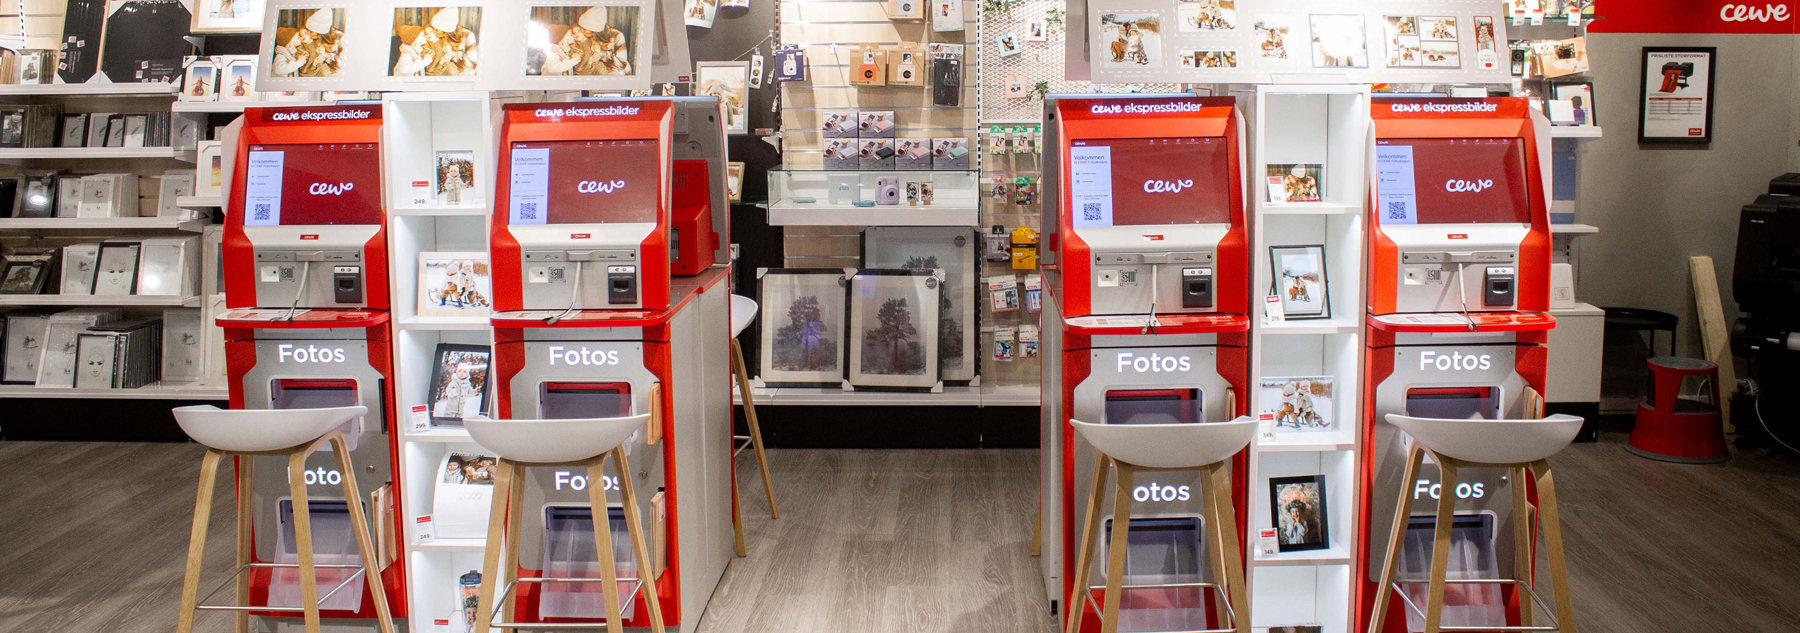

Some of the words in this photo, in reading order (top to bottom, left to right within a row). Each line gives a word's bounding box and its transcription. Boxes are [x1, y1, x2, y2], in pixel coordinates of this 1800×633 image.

[1720, 4, 1791, 22] cewe
[273, 112, 300, 121] cewe
[301, 109, 371, 121] ekspressbilder
[535, 108, 564, 117] cewe
[566, 105, 640, 118] ekspressbilder
[1091, 104, 1123, 114] cewe
[1124, 102, 1202, 115] ekspressbilder
[1391, 103, 1421, 113] cewe
[1423, 101, 1498, 114] ekspressbilder
[279, 344, 345, 363] Fotos
[549, 346, 619, 366] Fotos
[1117, 352, 1191, 373] Fotos
[1420, 351, 1491, 371] Fotos
[287, 466, 342, 485] oto
[555, 471, 620, 491] Foos
[1133, 482, 1190, 502] otos
[1414, 479, 1484, 499] Foos
